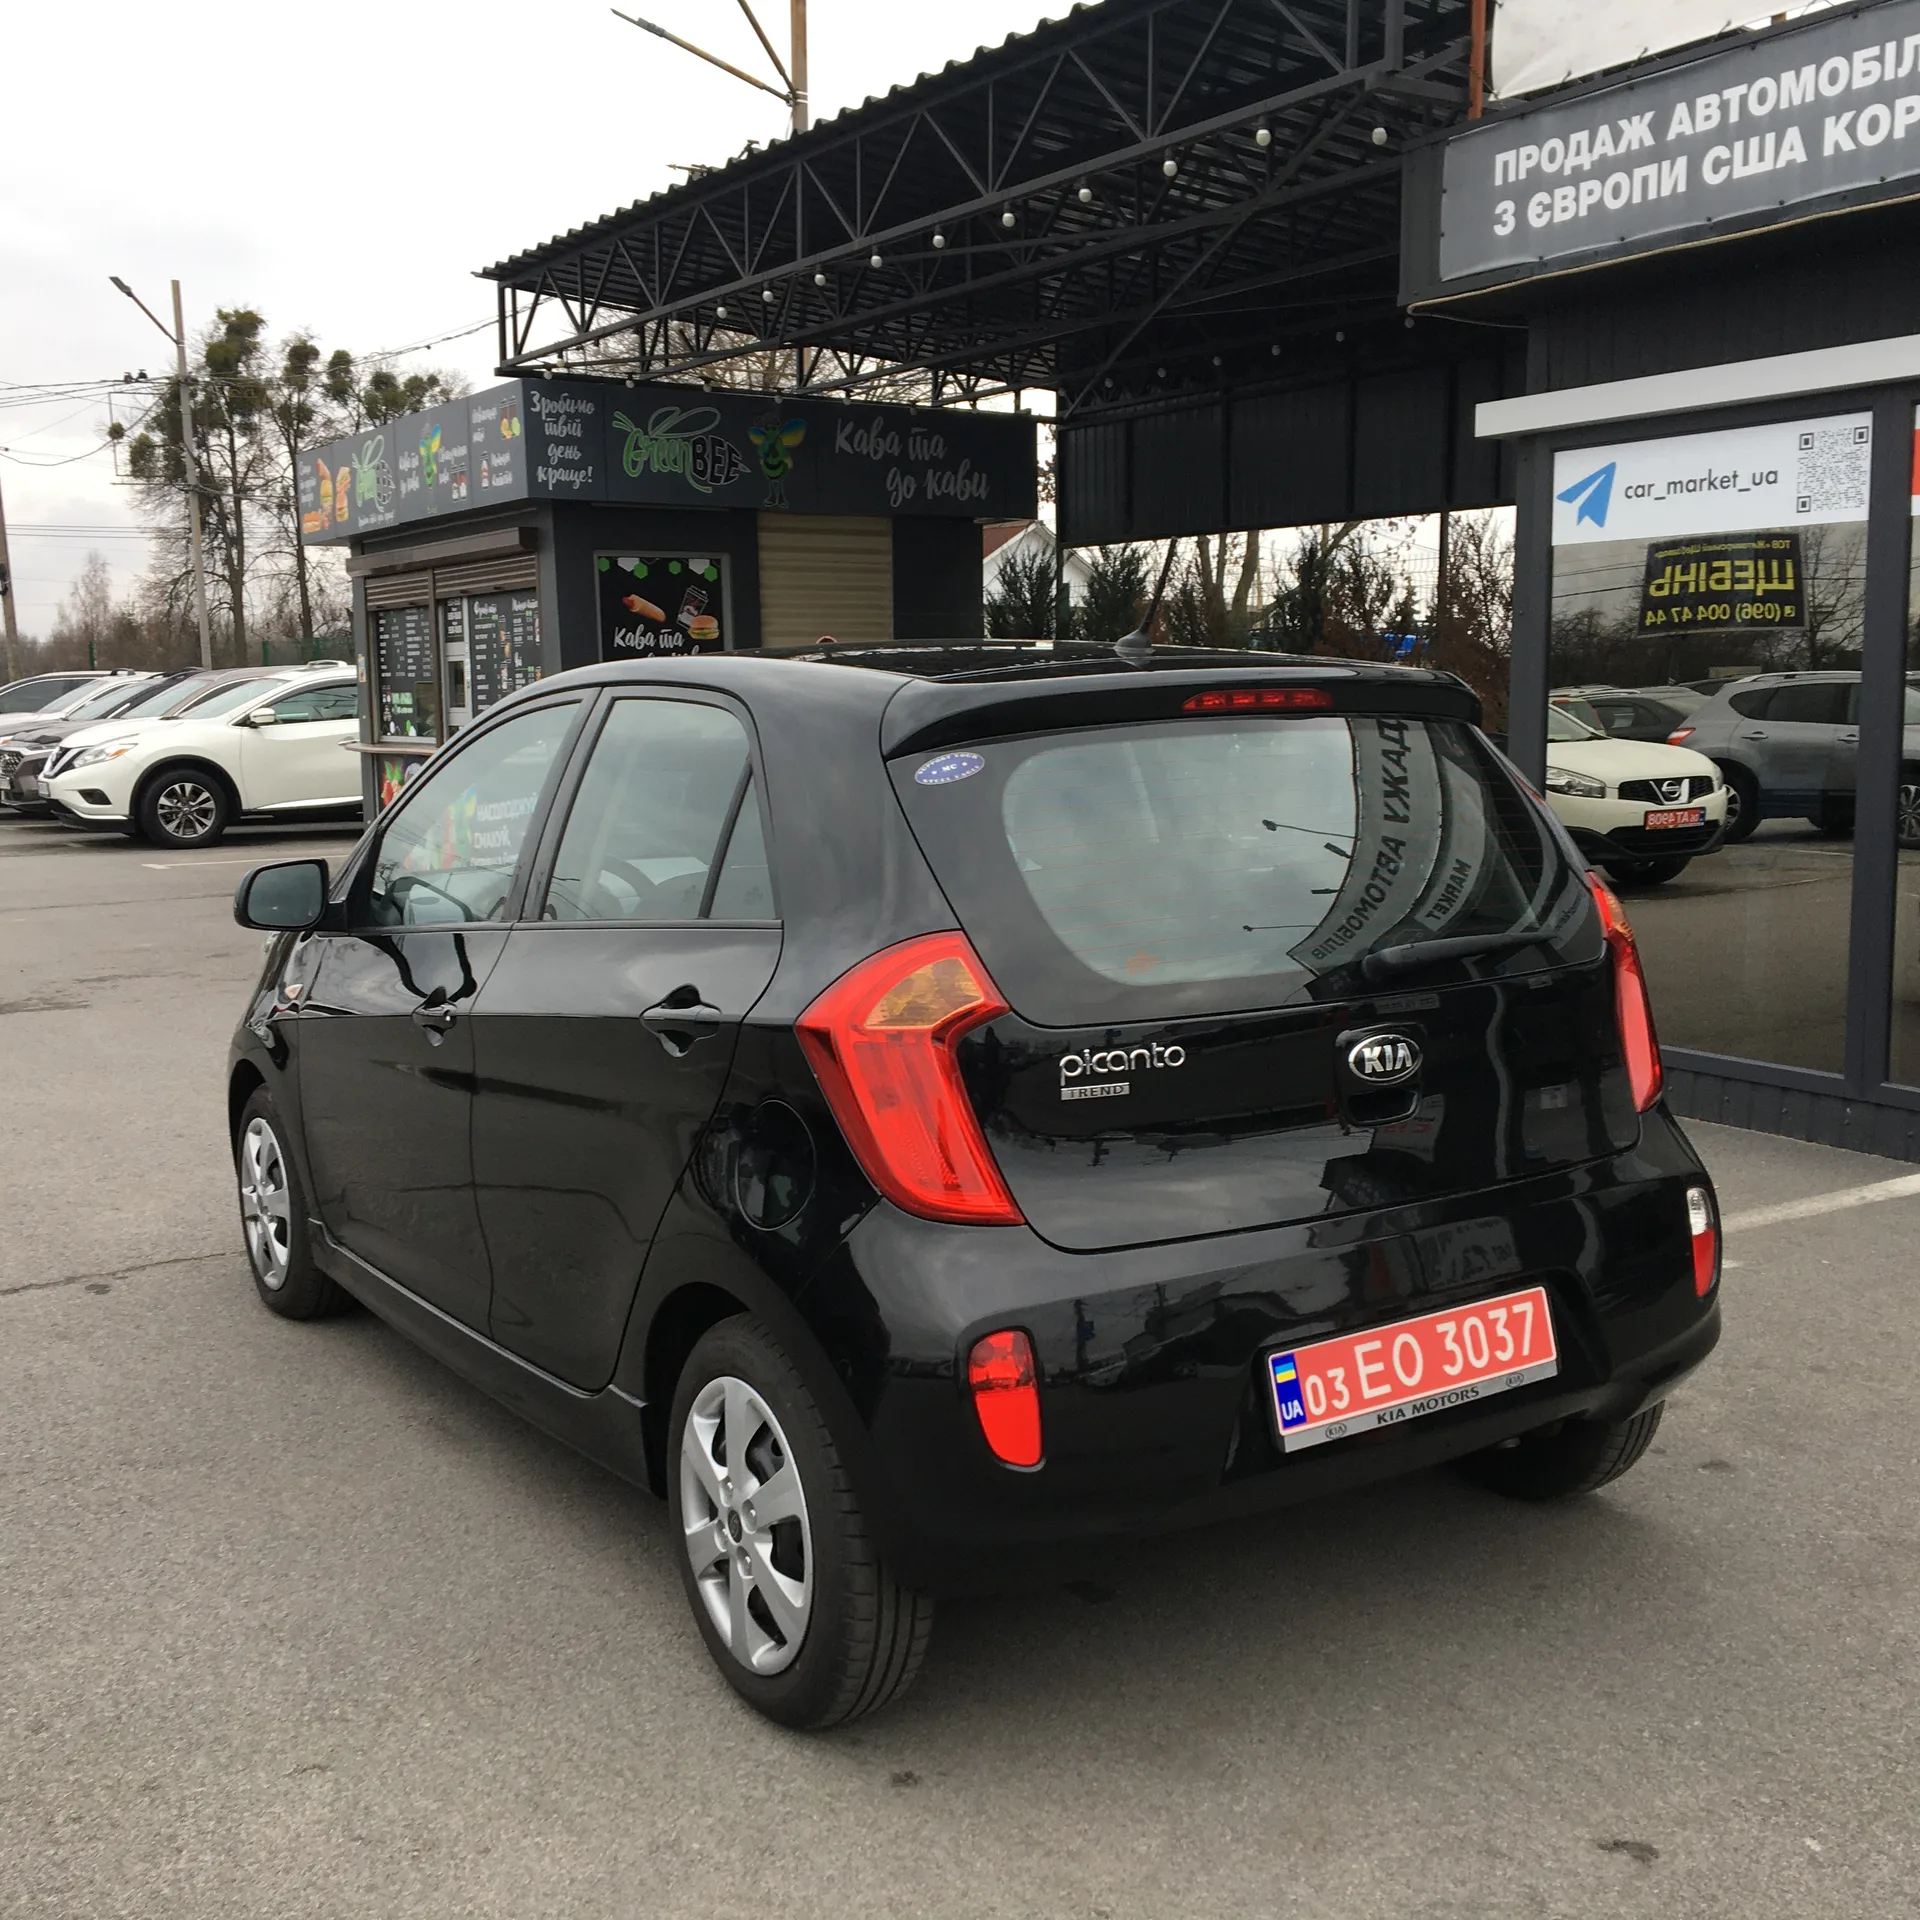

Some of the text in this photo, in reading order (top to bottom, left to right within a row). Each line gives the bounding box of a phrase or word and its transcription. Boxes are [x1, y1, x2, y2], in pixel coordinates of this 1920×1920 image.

[1494, 110, 1656, 186] ПРОДАЖ
[1493, 95, 1920, 235] З ЄВРОПИ США КОР
[530, 391, 595, 420] Зробимо
[544, 414, 583, 437] твій
[835, 416, 947, 461] Кава та
[547, 443, 582, 465] день
[536, 465, 593, 491] краще!
[886, 458, 990, 508] до кави
[1624, 468, 1779, 500] car_market_ua
[613, 624, 685, 650] Кава та
[1059, 1042, 1186, 1087] picanto
[1361, 1042, 1413, 1074] KIA
[1068, 1085, 1124, 1099] TREND
[1436, 1301, 1534, 1376] 3037
[1281, 1399, 1304, 1420] UA
[1376, 1386, 1479, 1424] KIA MOTORS
